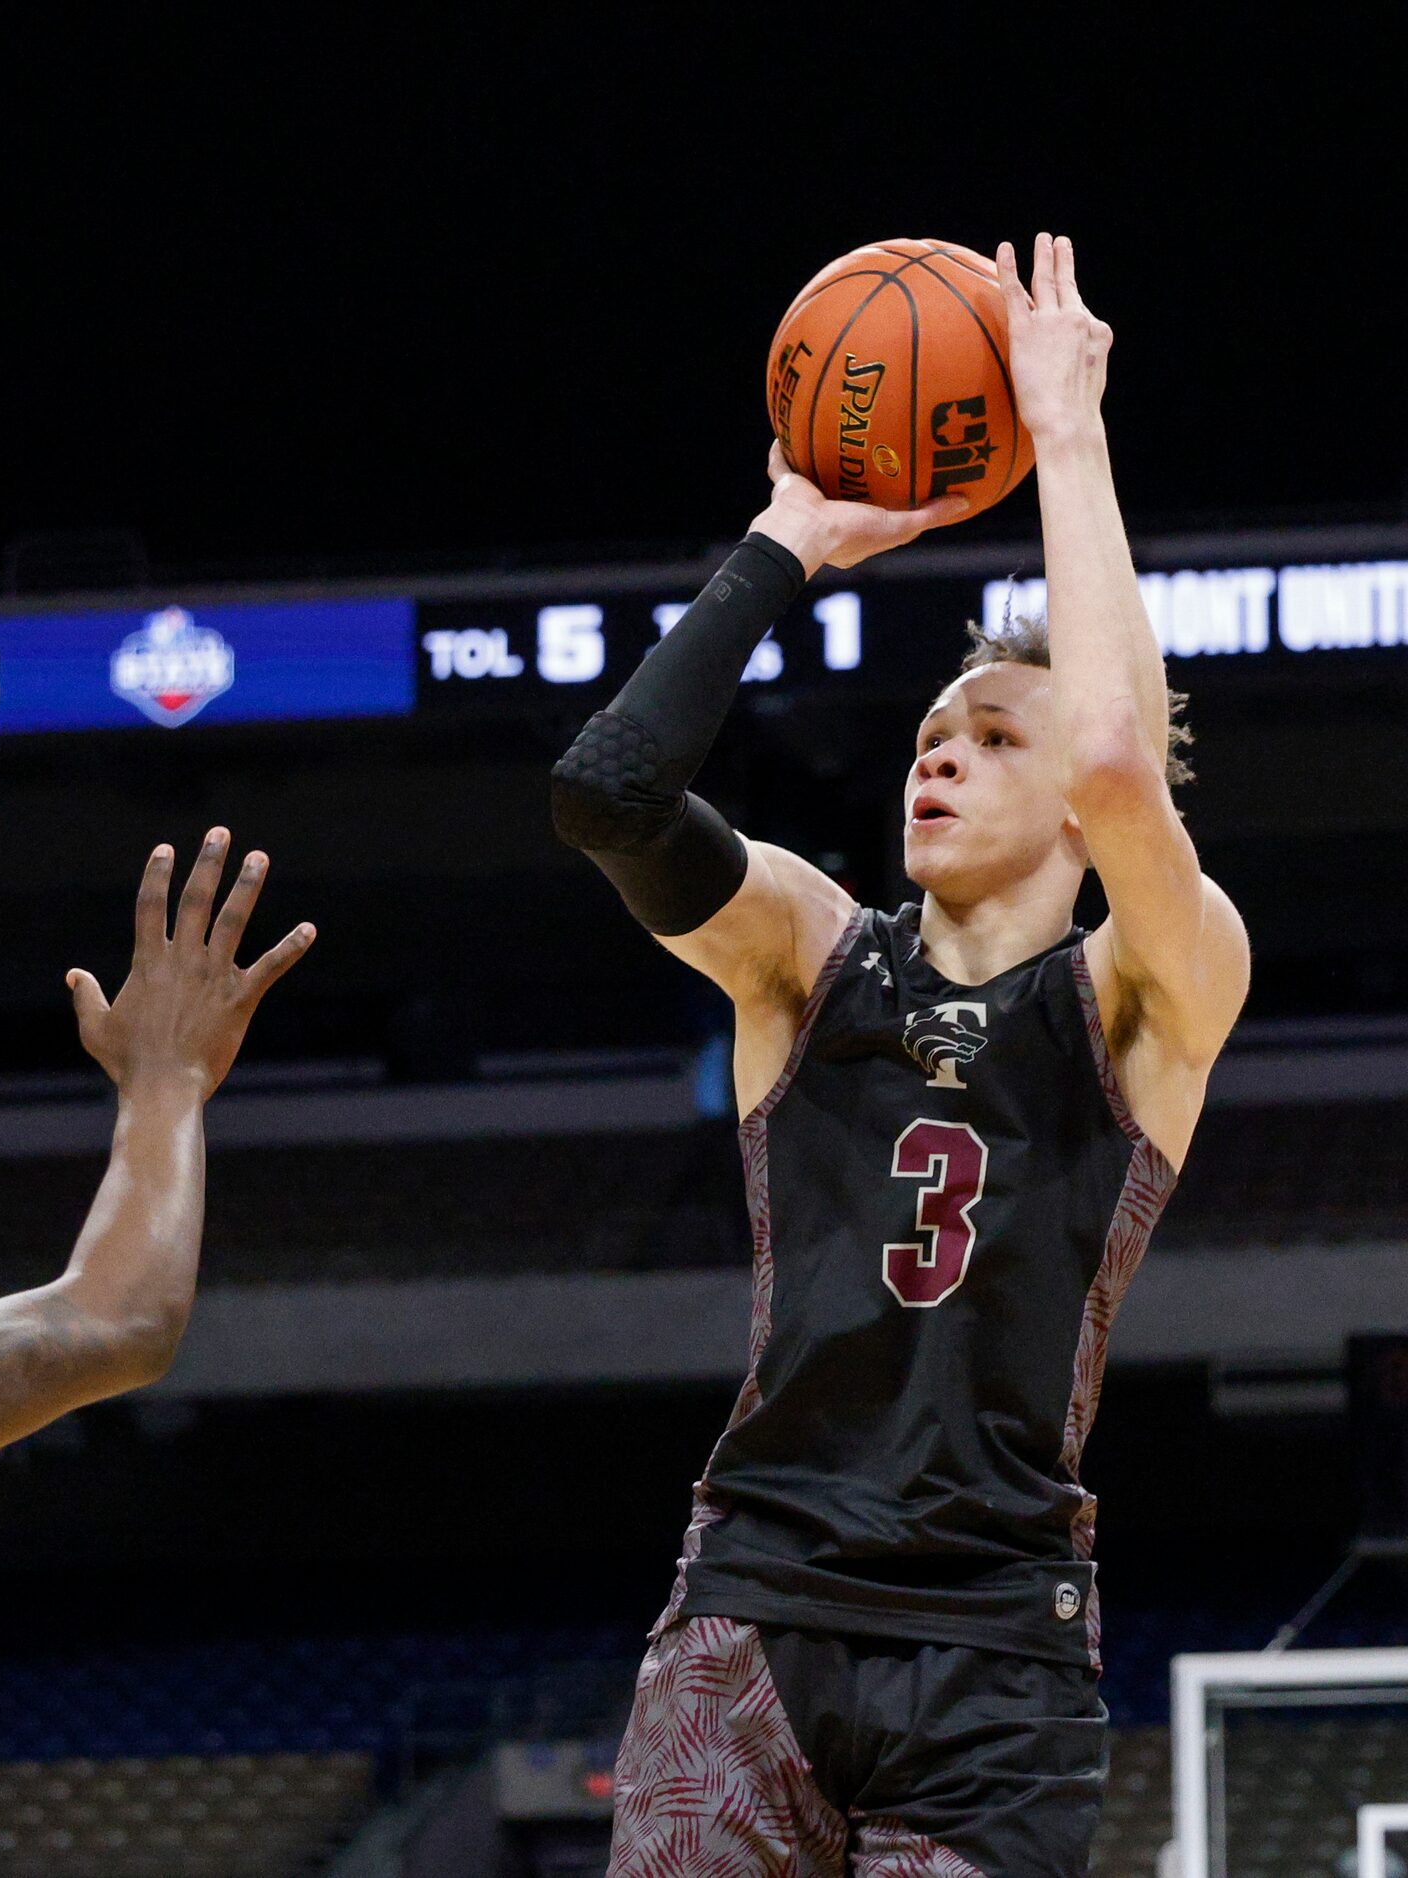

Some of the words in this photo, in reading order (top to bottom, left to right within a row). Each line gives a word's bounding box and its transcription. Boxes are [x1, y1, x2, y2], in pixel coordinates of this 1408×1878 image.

[840, 353, 886, 500] SPALDIN
[422, 628, 523, 681] TOL
[537, 604, 605, 684] 5
[813, 591, 862, 671] 1
[1278, 560, 1408, 652] UNIT
[882, 1117, 989, 1308] 3
